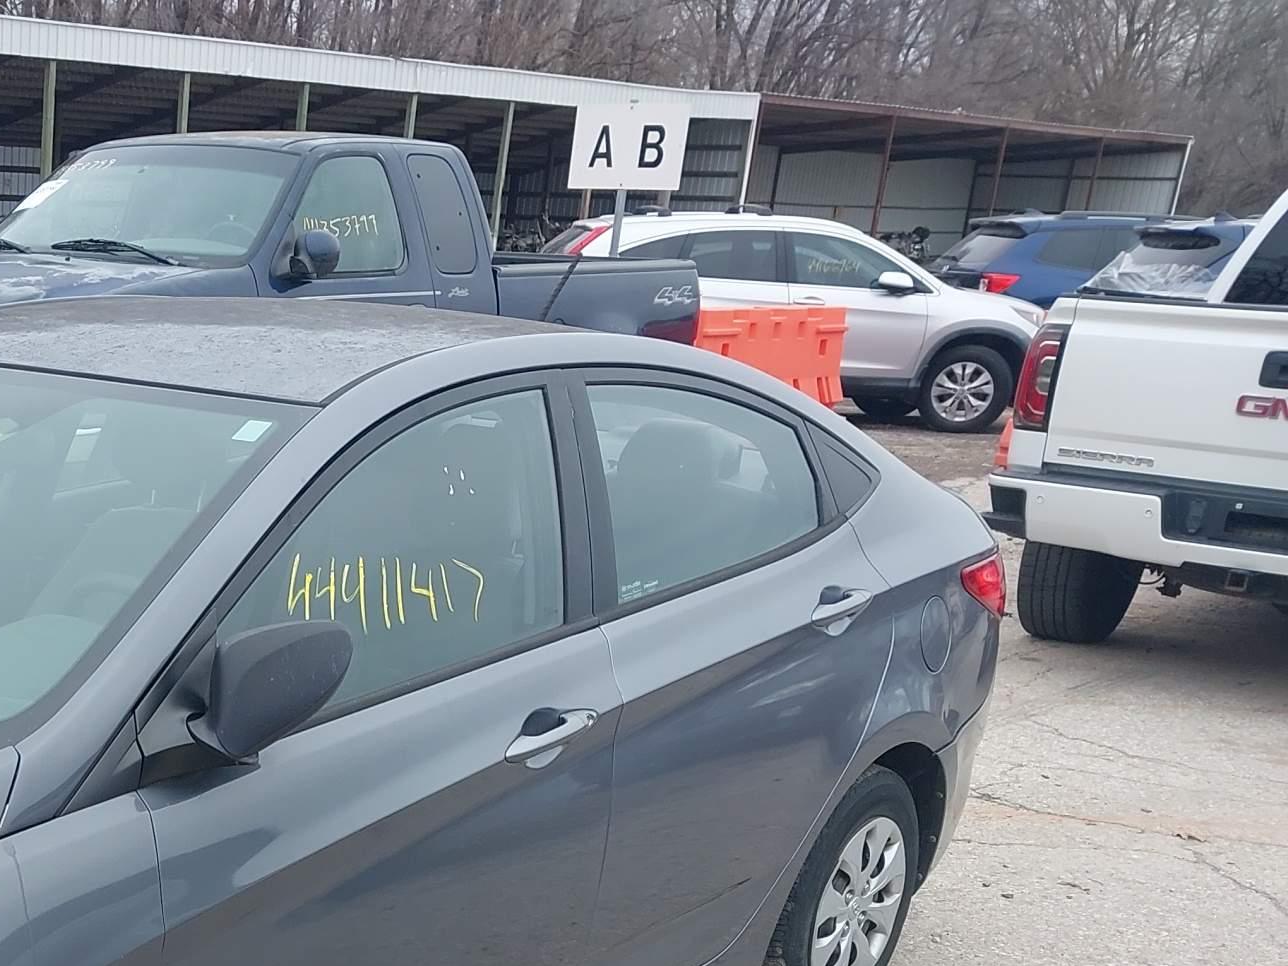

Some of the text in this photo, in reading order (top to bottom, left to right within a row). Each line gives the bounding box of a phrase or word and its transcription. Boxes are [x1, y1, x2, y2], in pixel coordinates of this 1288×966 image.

[588, 124, 666, 168] A B
[1056, 447, 1155, 468] SIERRA
[287, 552, 484, 634] 44411417
